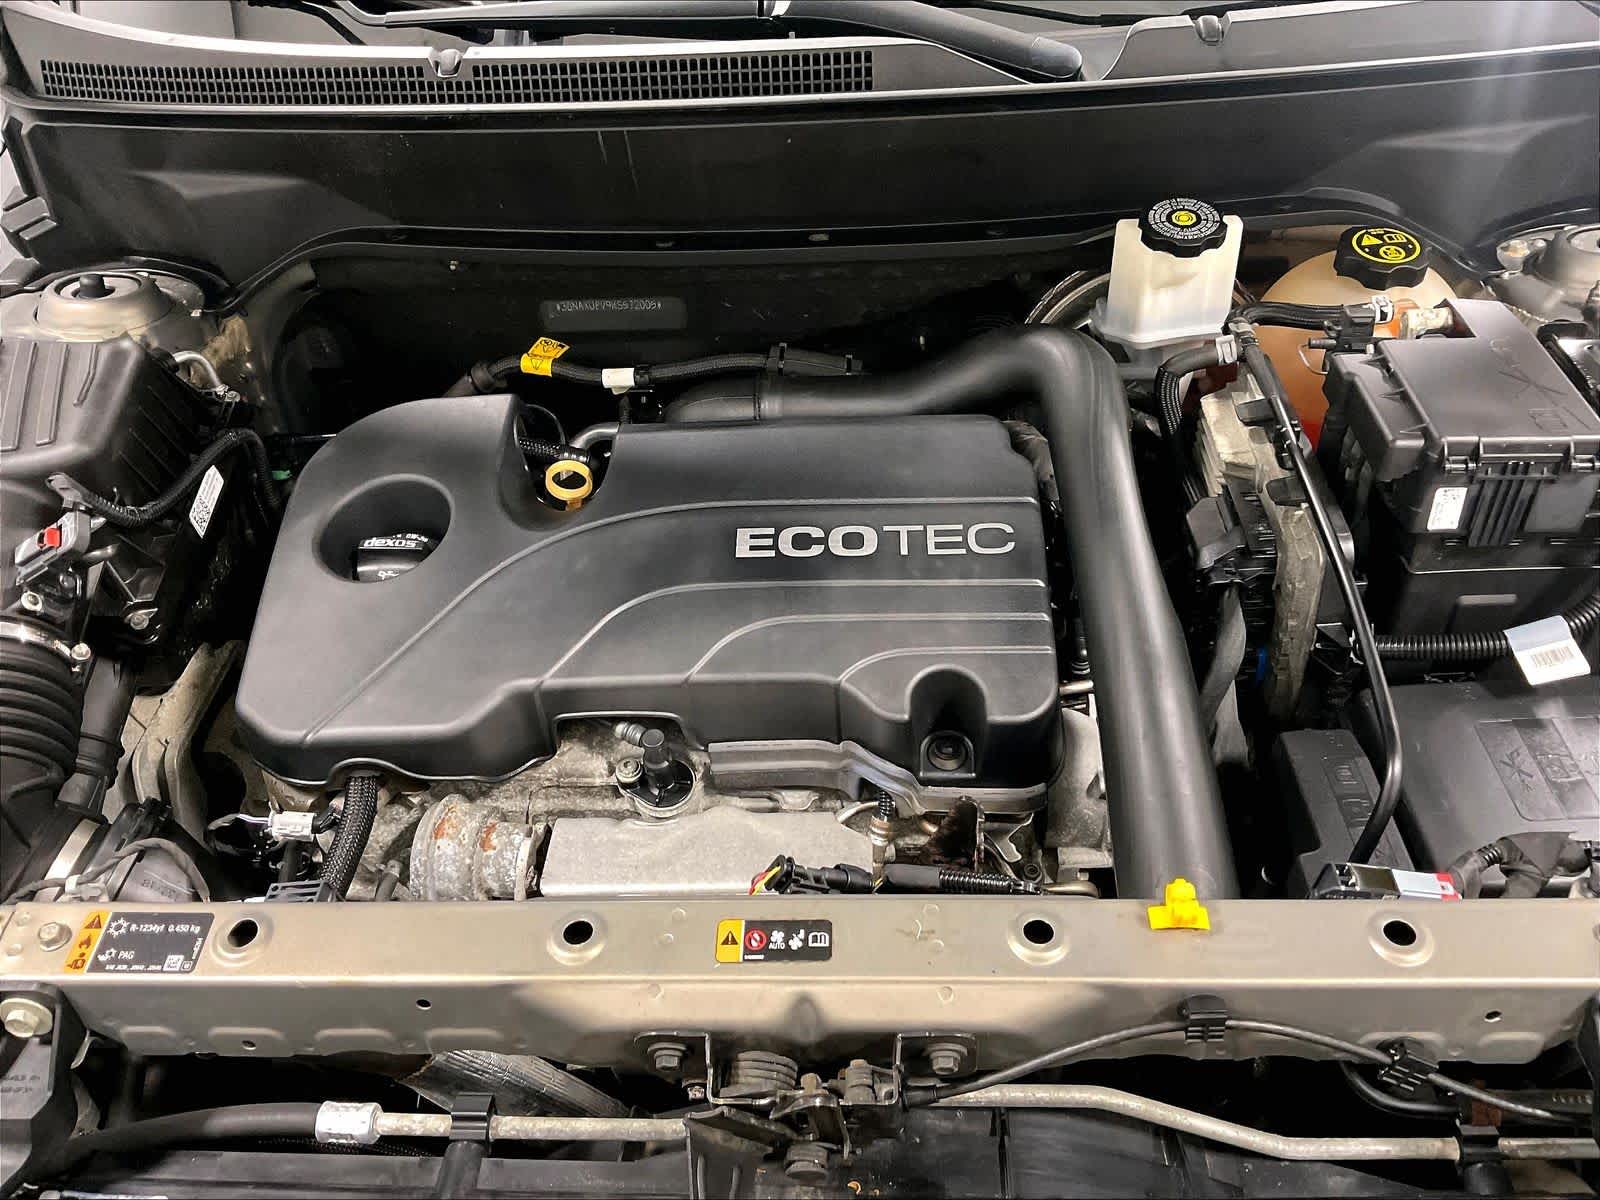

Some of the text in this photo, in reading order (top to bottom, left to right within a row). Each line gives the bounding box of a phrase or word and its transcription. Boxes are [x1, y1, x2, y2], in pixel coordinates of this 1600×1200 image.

[363, 537, 418, 549] dexos
[736, 522, 1016, 558] ECOTEC
[190, 923, 201, 935] kg
[768, 942, 786, 950] AUTO
[118, 950, 136, 960] PAG
